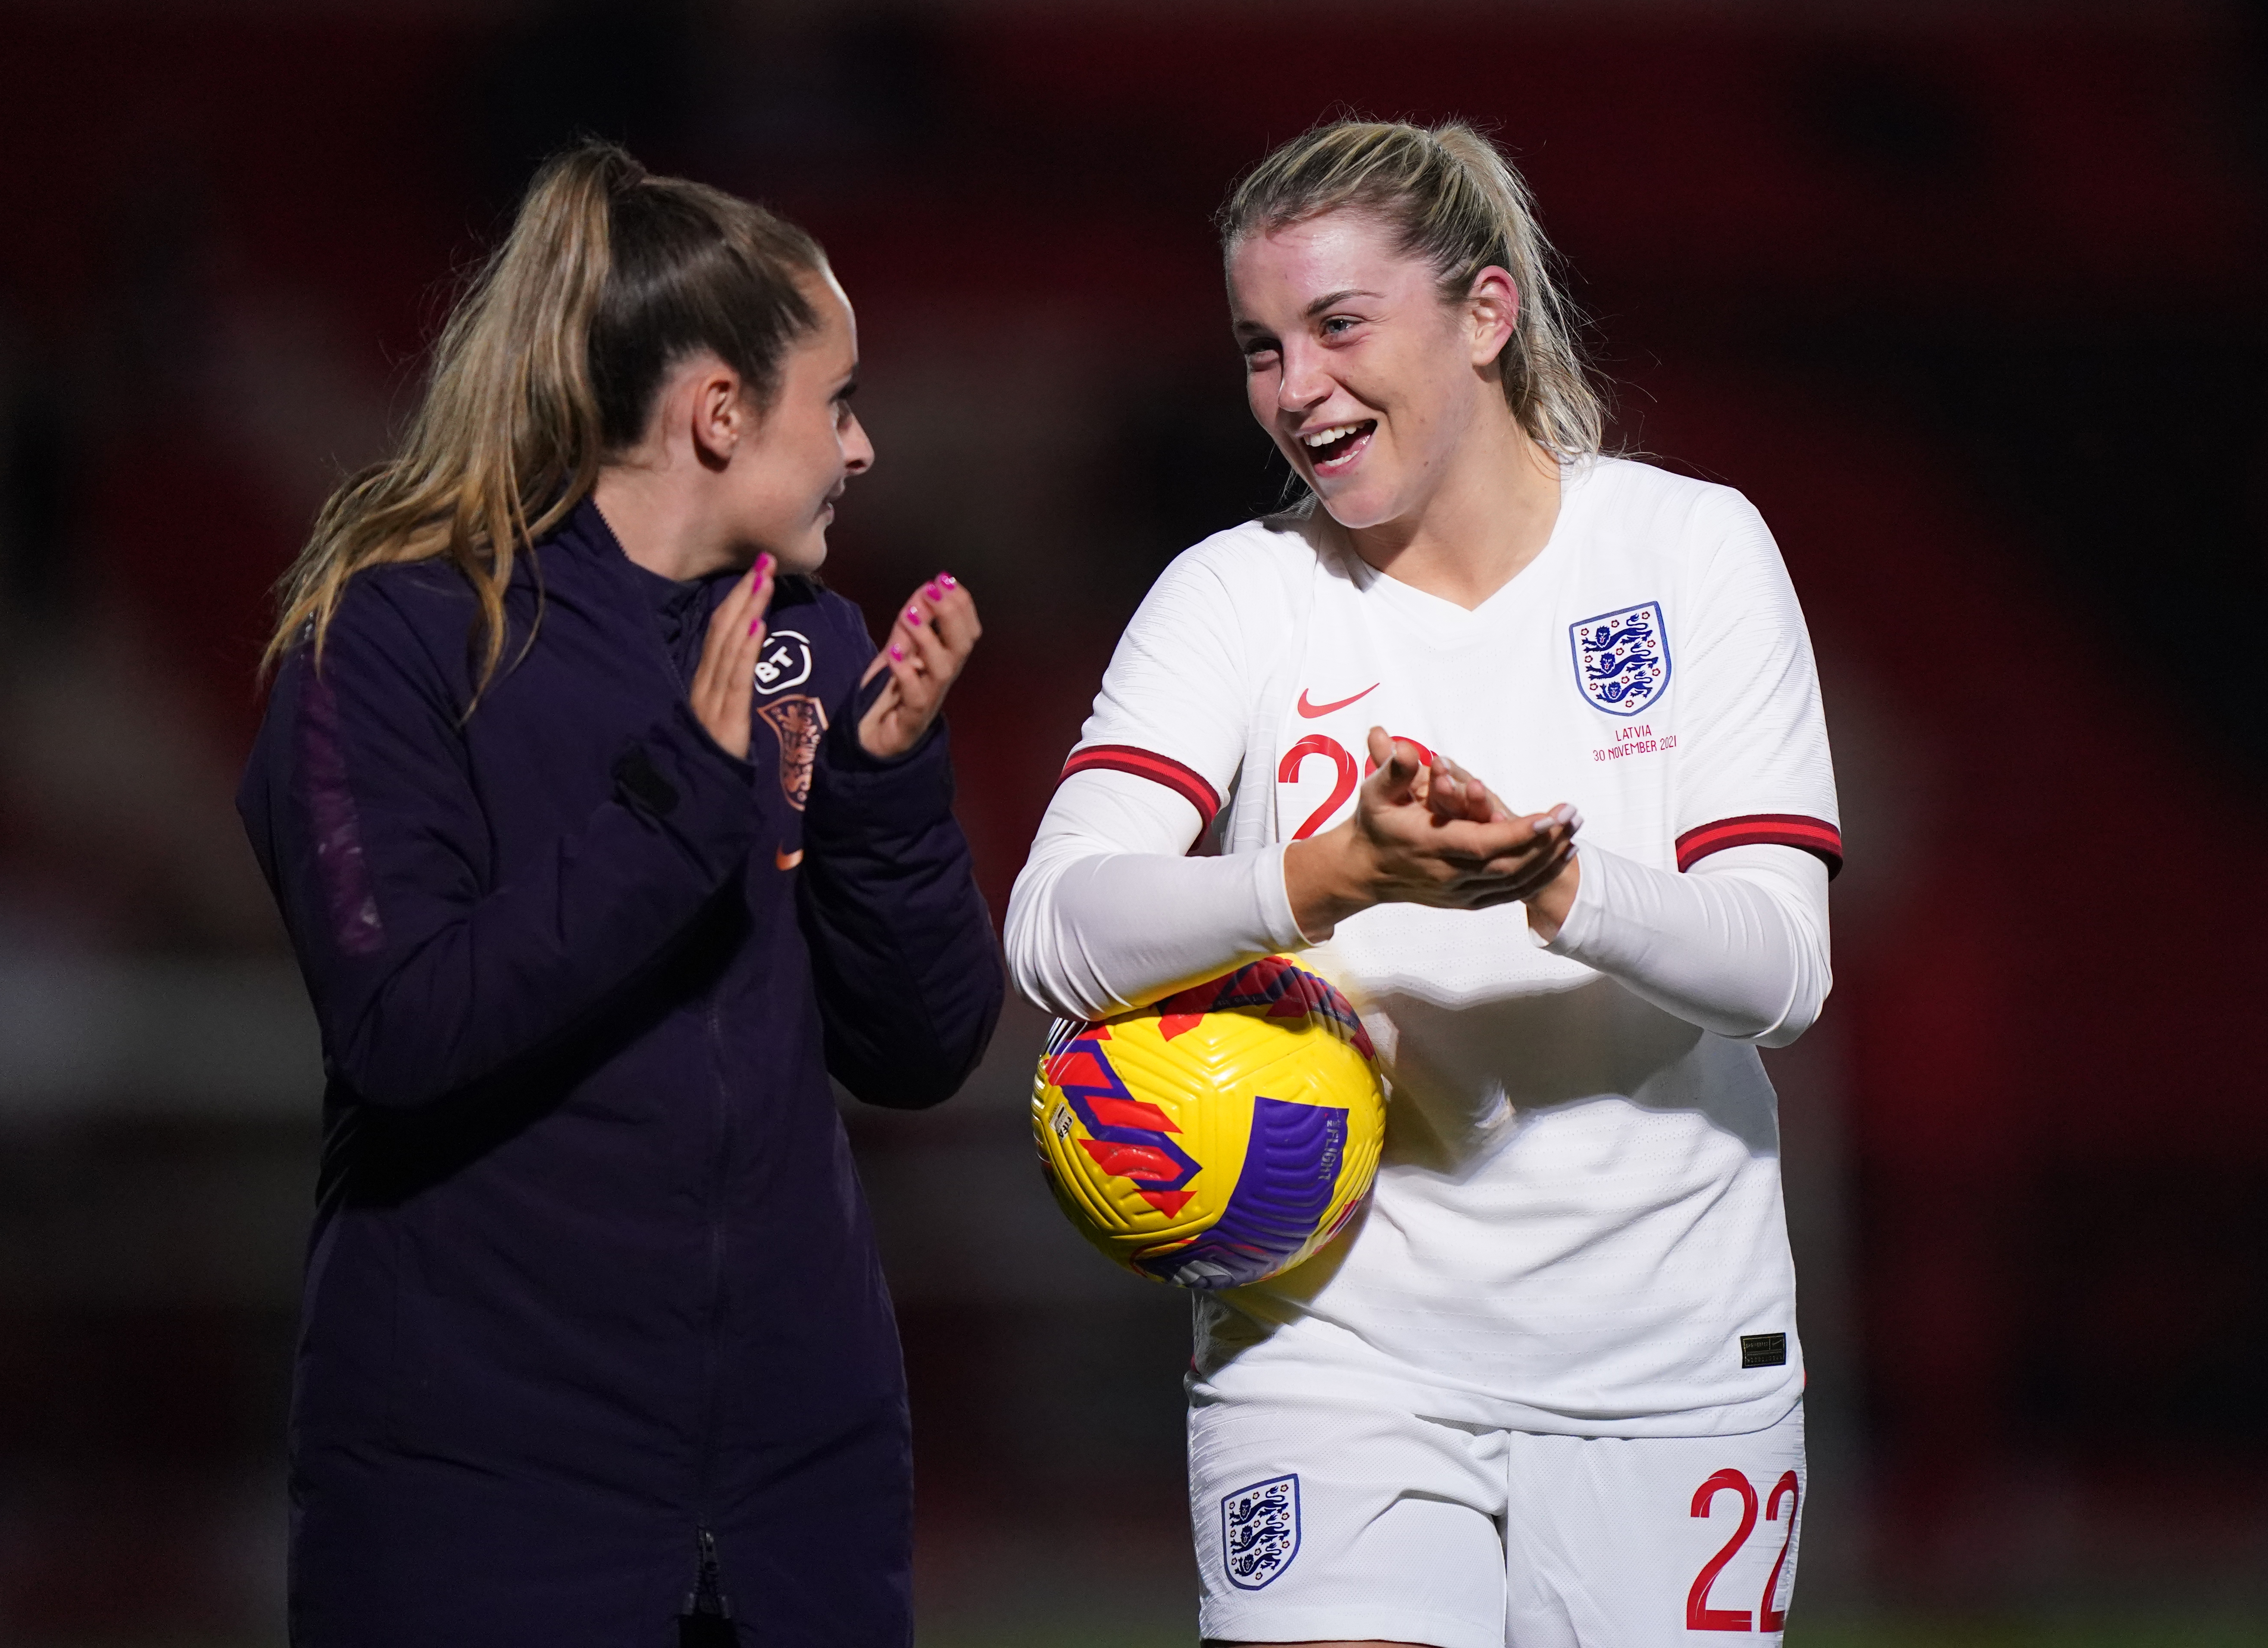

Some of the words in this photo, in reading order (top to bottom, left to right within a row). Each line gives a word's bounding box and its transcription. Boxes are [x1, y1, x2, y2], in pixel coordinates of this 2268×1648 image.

[755, 646, 793, 684] BT
[1593, 749, 1606, 761] 30
[1608, 740, 1657, 760] NOVEMBER
[1660, 735, 1677, 750] 2021
[1615, 725, 1652, 742] LATVIA
[1318, 1128, 1339, 1180] FLIGHT
[1687, 1468, 1799, 1632] 22
